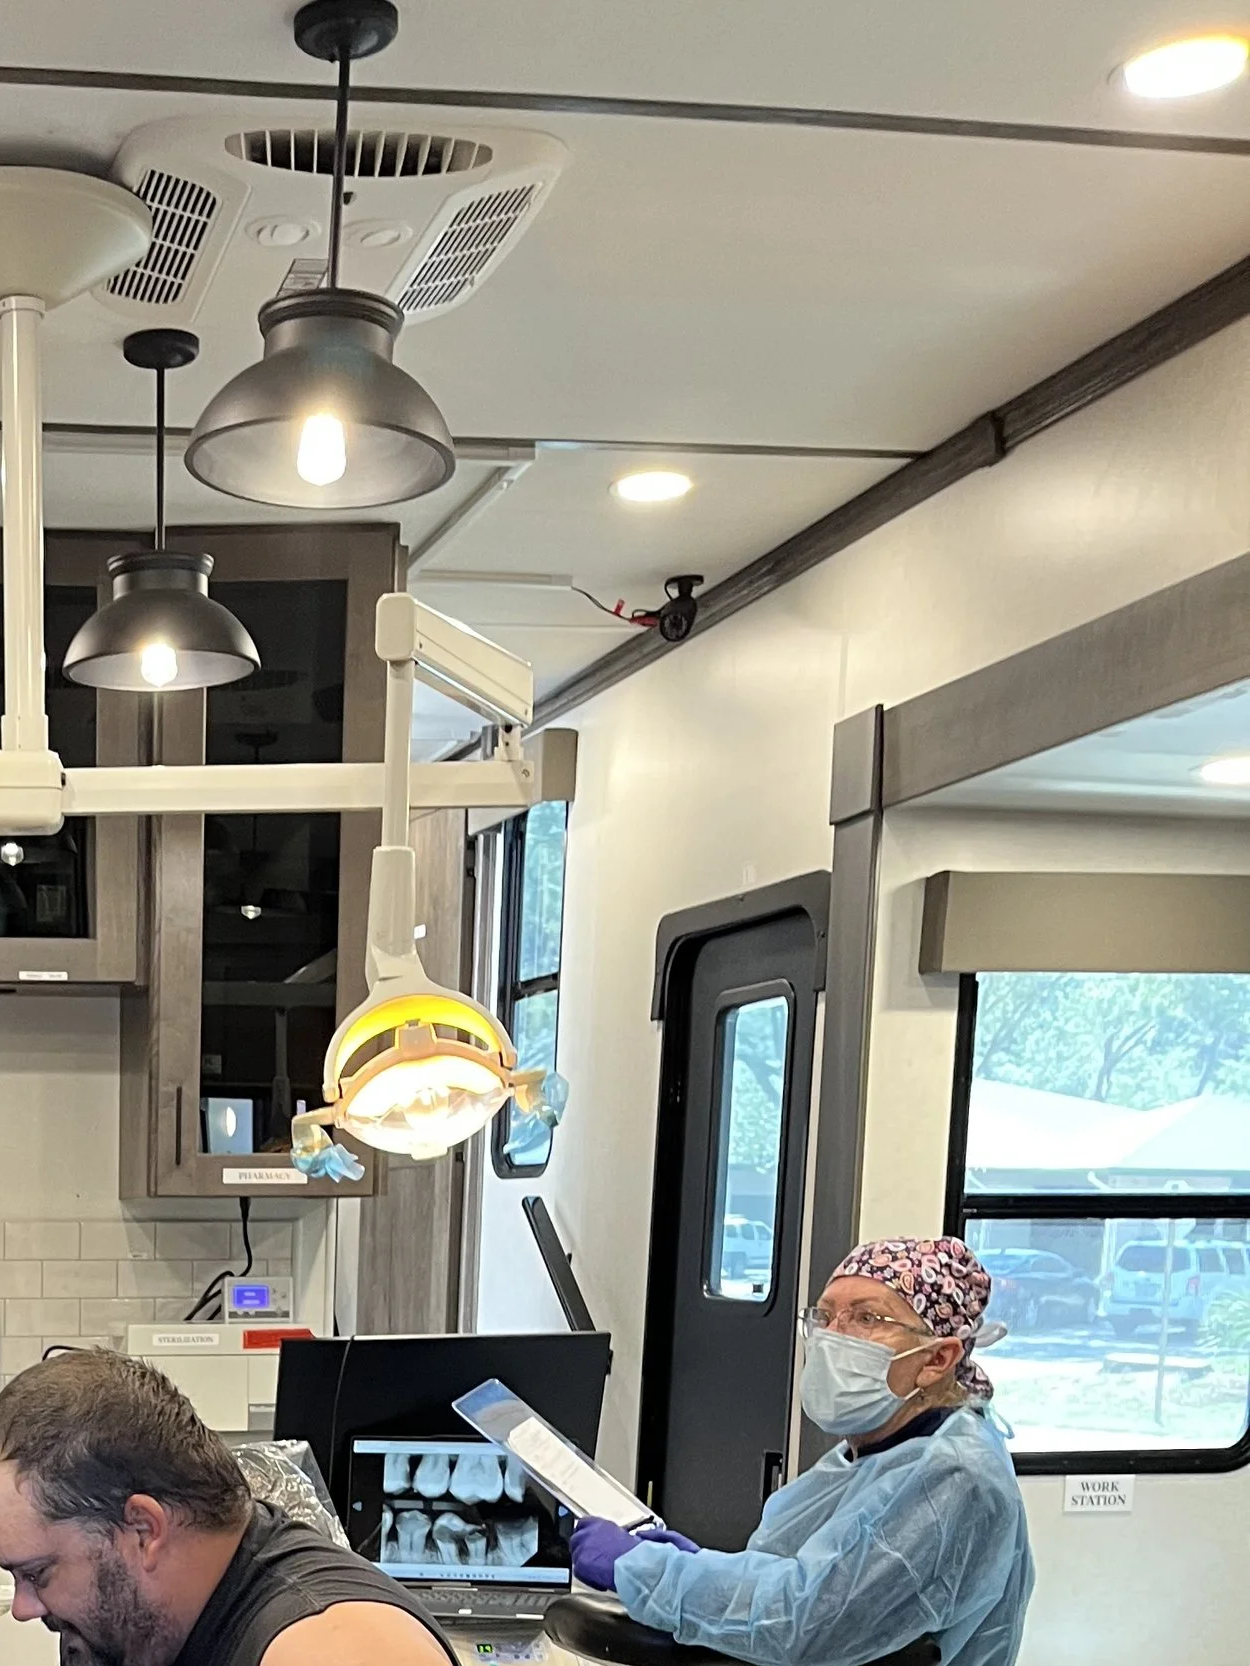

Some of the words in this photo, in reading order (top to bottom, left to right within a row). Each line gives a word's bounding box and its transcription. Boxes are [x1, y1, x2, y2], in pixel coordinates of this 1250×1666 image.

[238, 1171, 291, 1181] PHARMACY
[157, 1335, 215, 1344] STERILIZATION
[1080, 1480, 1120, 1493] WORK
[1070, 1493, 1127, 1507] STATION
